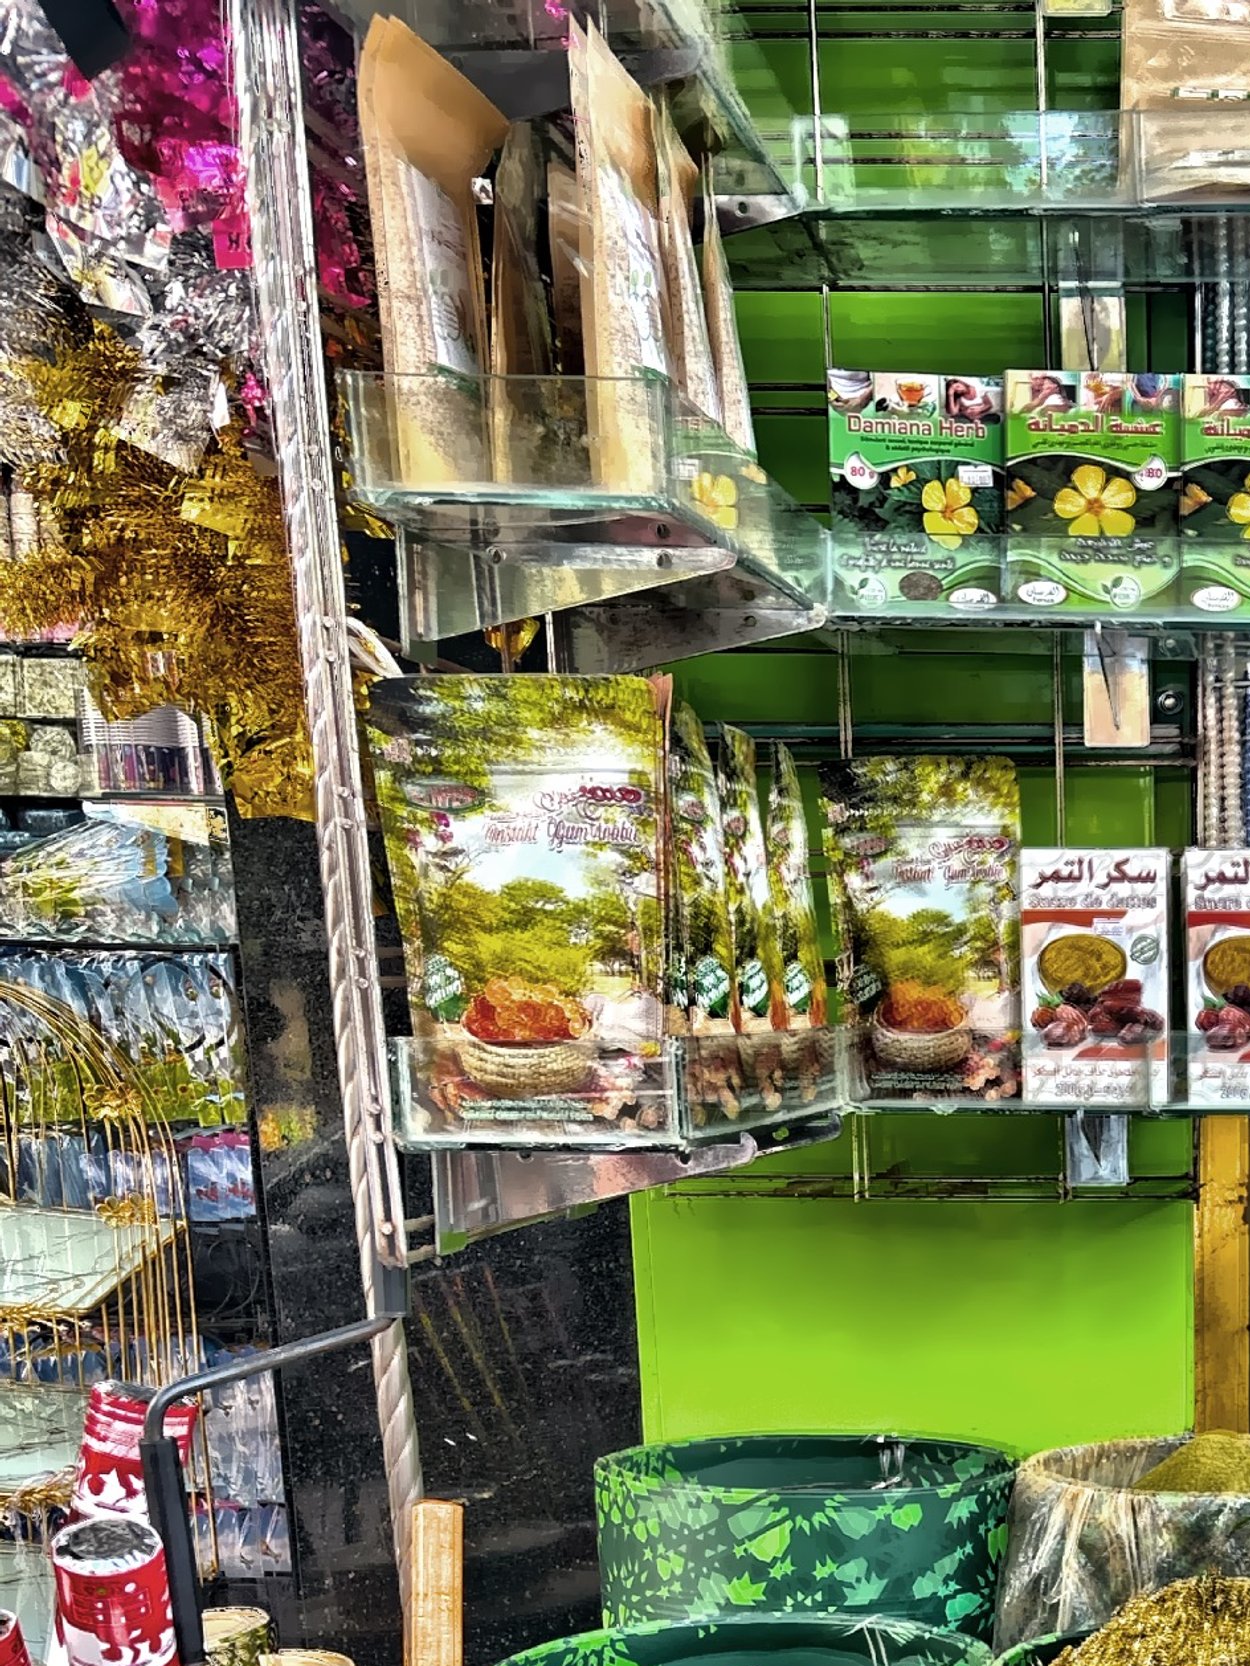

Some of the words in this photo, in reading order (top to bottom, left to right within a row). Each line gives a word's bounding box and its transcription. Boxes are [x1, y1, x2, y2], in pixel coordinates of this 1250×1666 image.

[847, 413, 932, 436] Damiana
[939, 416, 987, 439] Herb
[850, 467, 865, 477] 80
[1028, 856, 1093, 890] التمر
[1095, 857, 1157, 890] سكر
